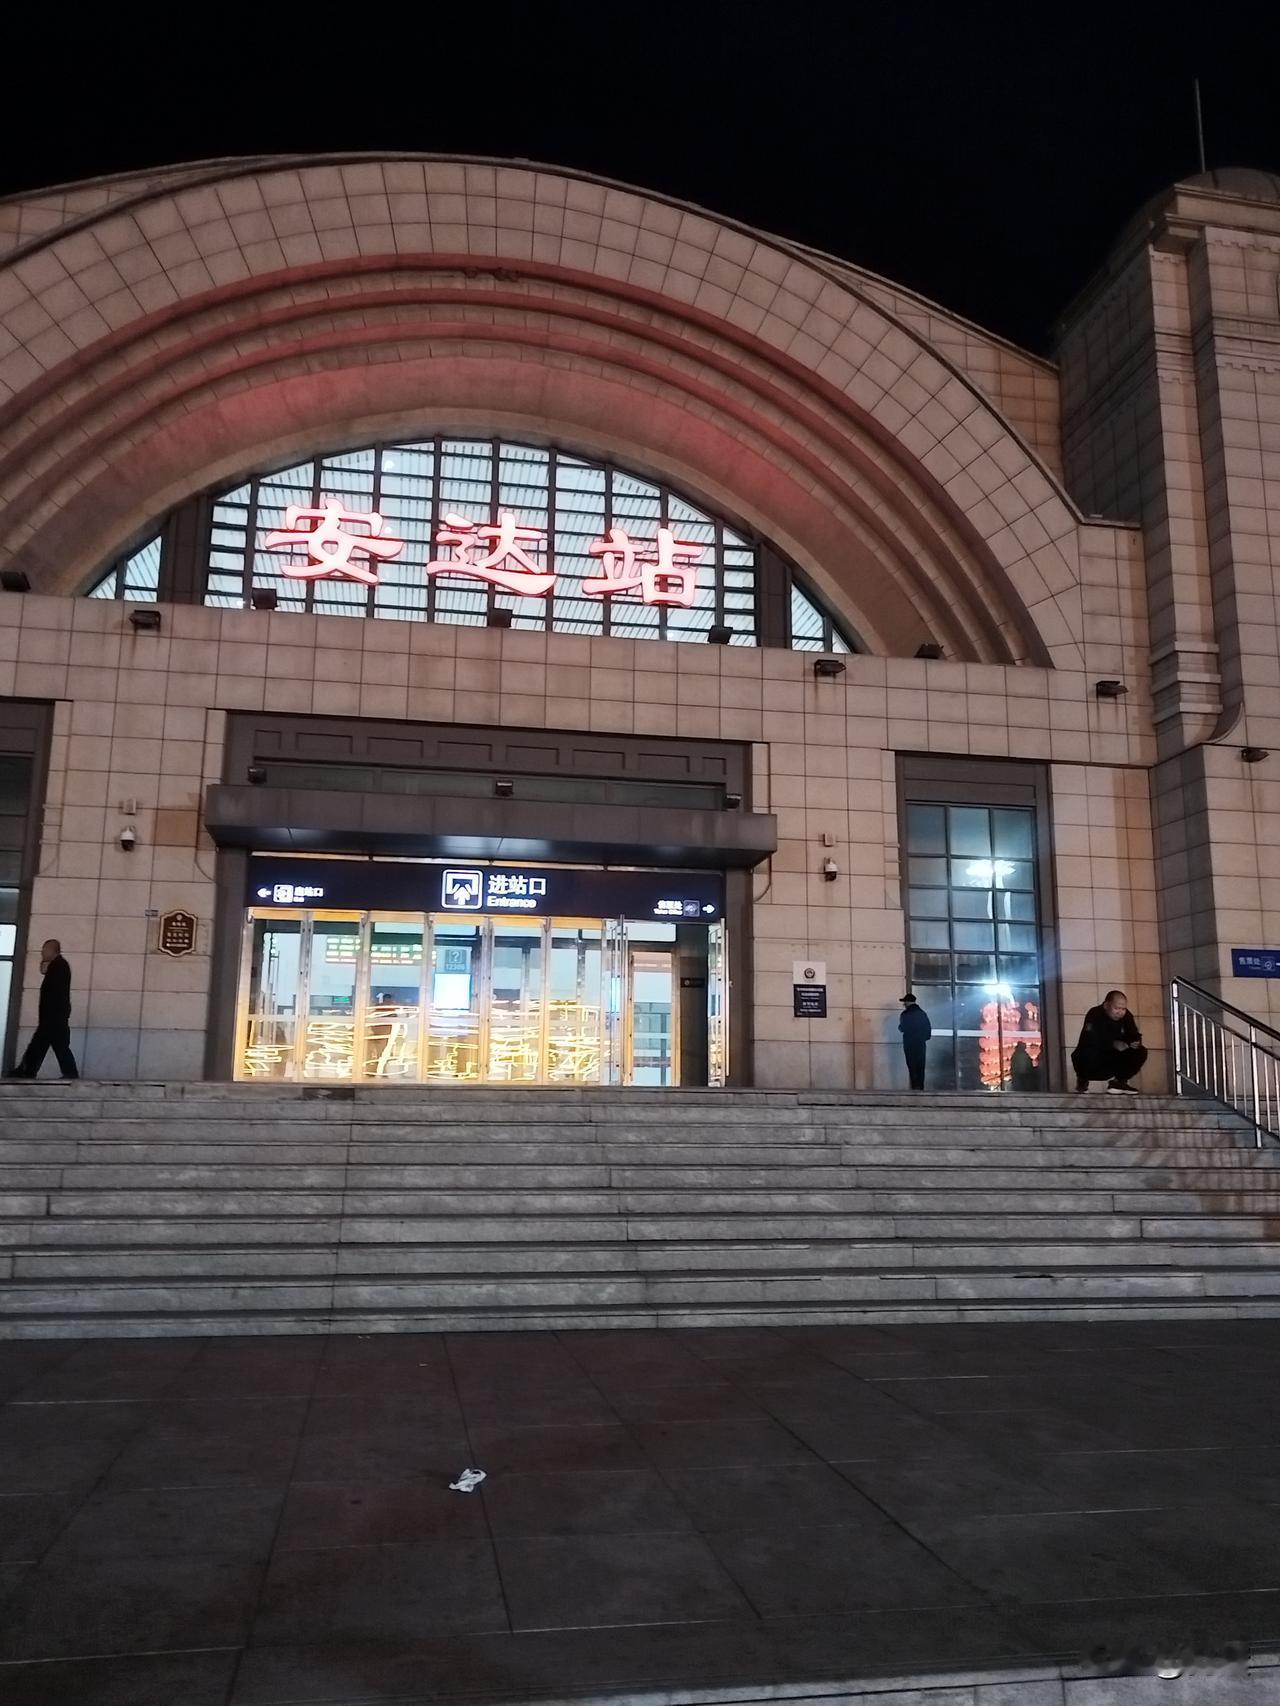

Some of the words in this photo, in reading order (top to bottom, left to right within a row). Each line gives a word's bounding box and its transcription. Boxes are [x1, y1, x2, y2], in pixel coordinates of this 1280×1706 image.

[264, 498, 703, 606] 安达站
[488, 875, 547, 895] 进站口
[487, 896, 537, 908] Entrance
